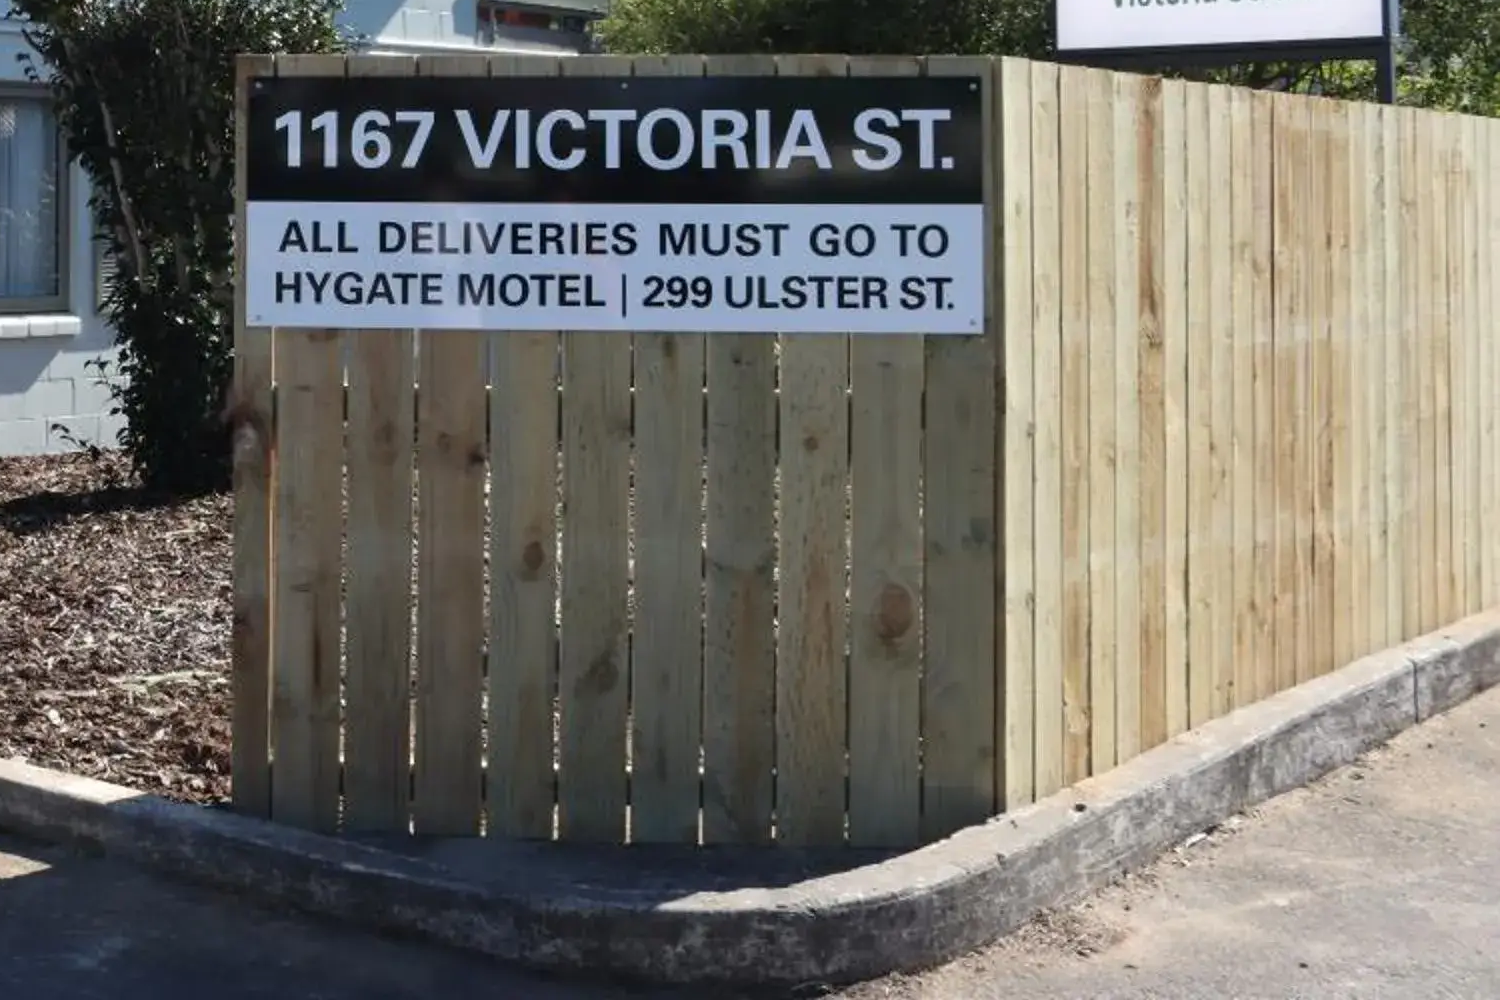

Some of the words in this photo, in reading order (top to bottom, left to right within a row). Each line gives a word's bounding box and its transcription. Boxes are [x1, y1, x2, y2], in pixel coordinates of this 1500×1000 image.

[276, 110, 434, 168] 1167
[455, 108, 832, 170] VICTORIA
[852, 108, 953, 170] ST.
[279, 221, 358, 253] ALL
[380, 222, 637, 255] DELIVERIES
[660, 224, 789, 256] MUST
[810, 224, 876, 257] GO
[890, 224, 948, 258] TO
[276, 272, 442, 304] HYGATE
[459, 274, 606, 307] MOTEL
[643, 276, 712, 308] 299
[725, 276, 888, 309] ULSTER
[900, 277, 953, 310] ST.
